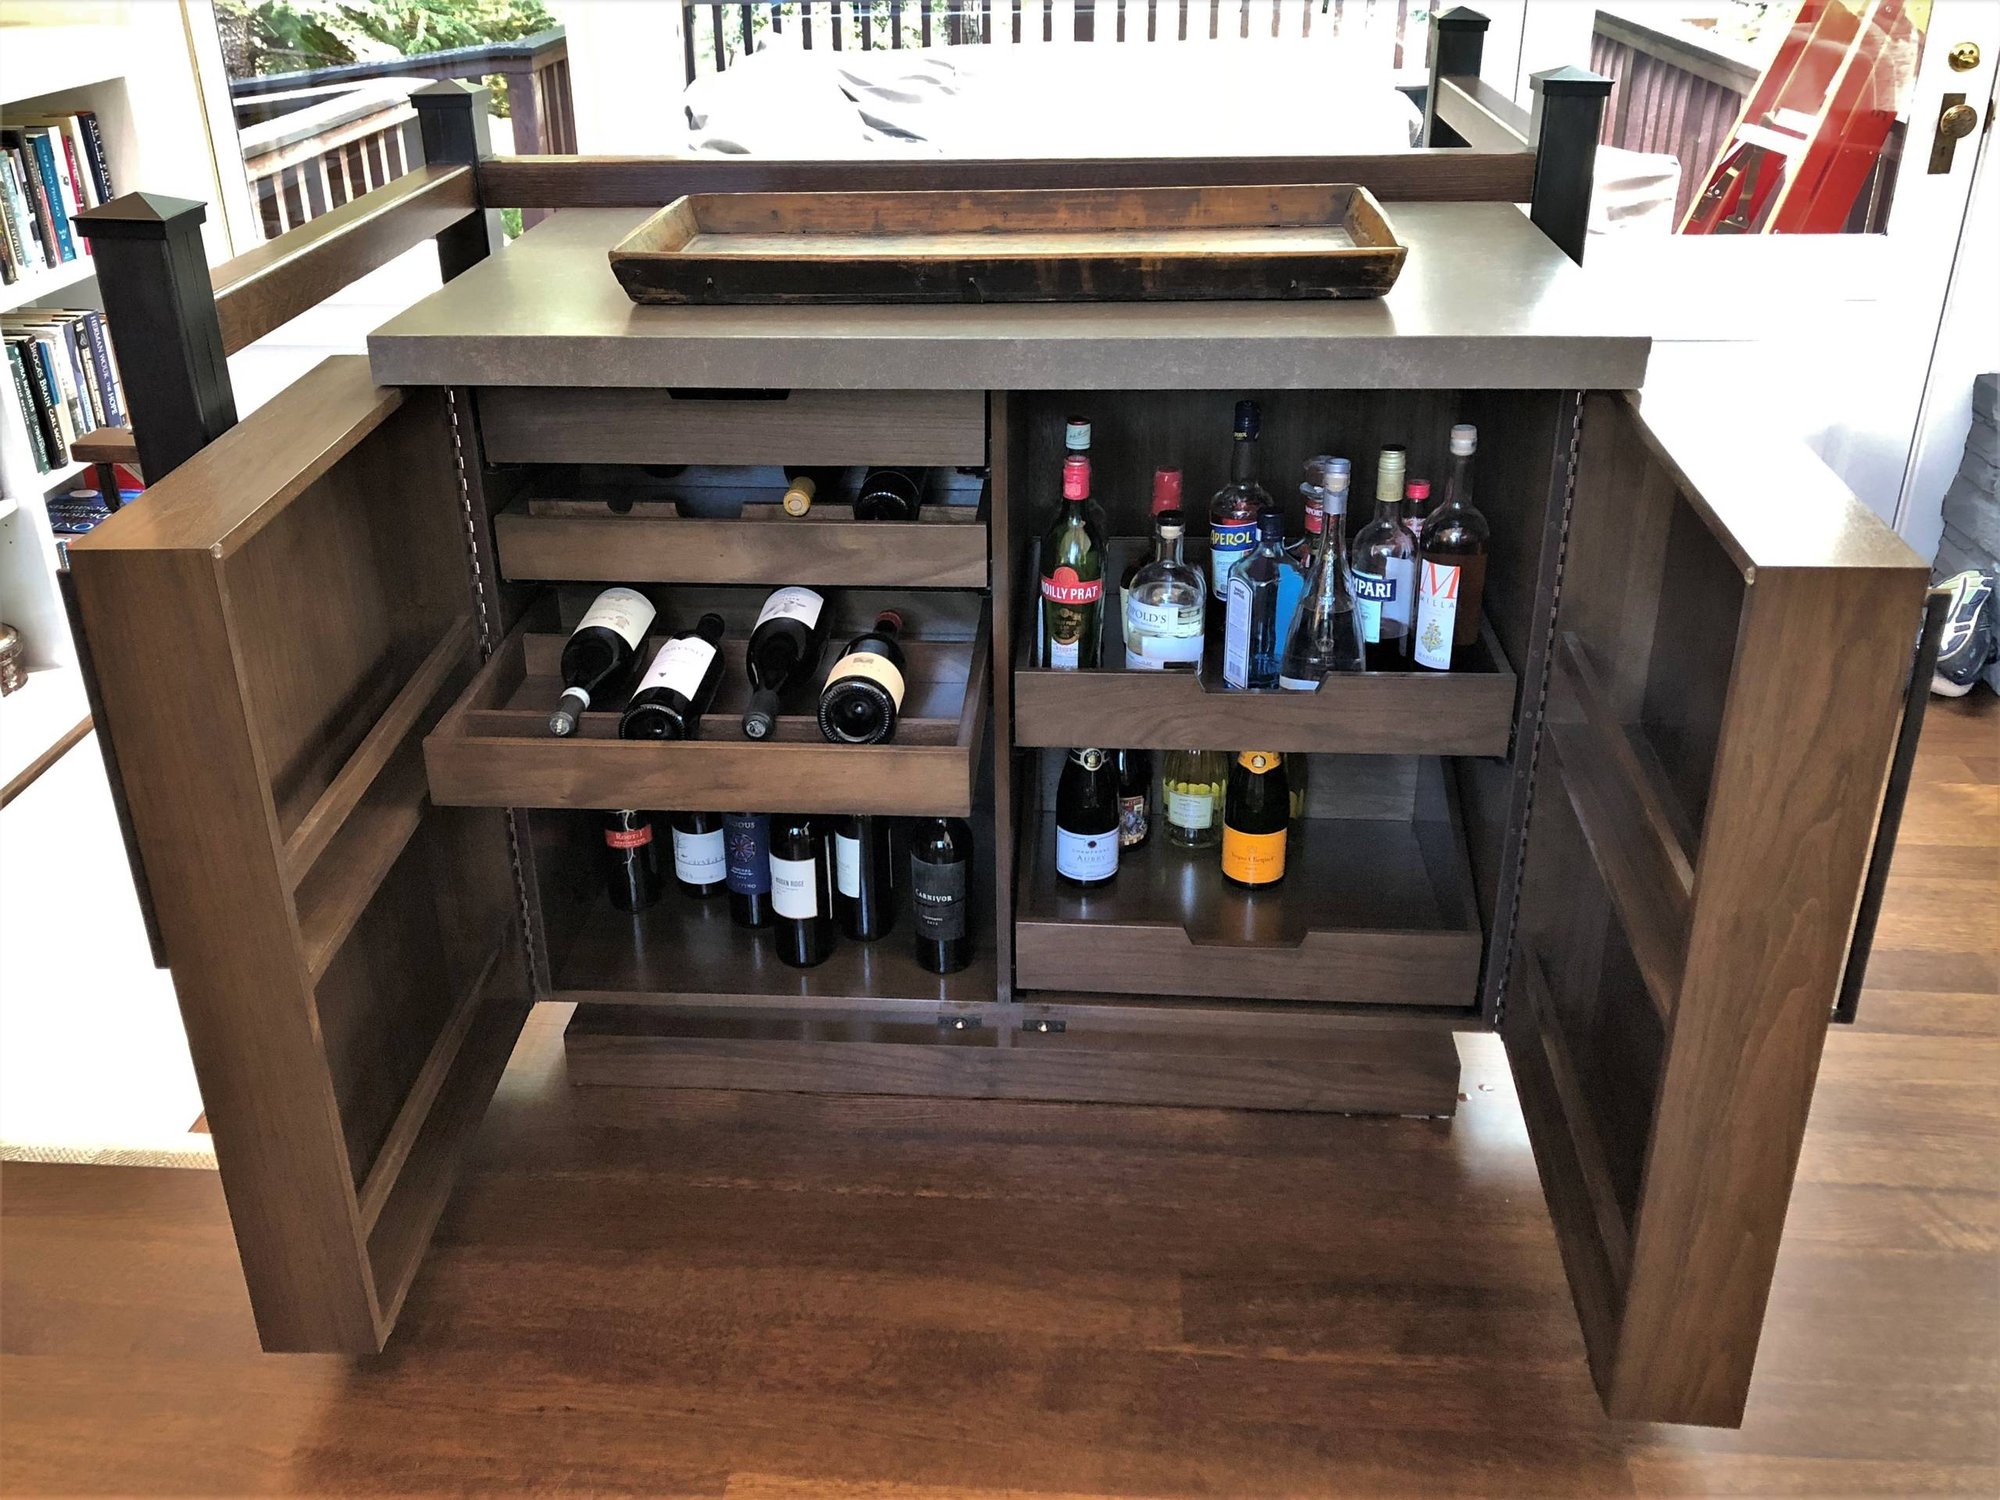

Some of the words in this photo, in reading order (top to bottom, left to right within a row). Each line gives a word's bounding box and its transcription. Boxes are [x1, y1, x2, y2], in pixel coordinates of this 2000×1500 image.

[50, 185, 61, 217] TRILOGY
[90, 316, 104, 353] HERMAN
[99, 353, 110, 379] WOUK
[107, 392, 118, 416] HOPE
[17, 357, 26, 380] NORA
[23, 380, 35, 413] ROBERTS
[34, 425, 47, 463] OBSESSION
[40, 379, 52, 407] BRAIN
[48, 408, 57, 428] CARL
[54, 428, 64, 451] SAGAN
[1211, 529, 1253, 546] APEROL
[1070, 585, 1098, 601] PRAT
[915, 888, 953, 903] CARNIVOR
